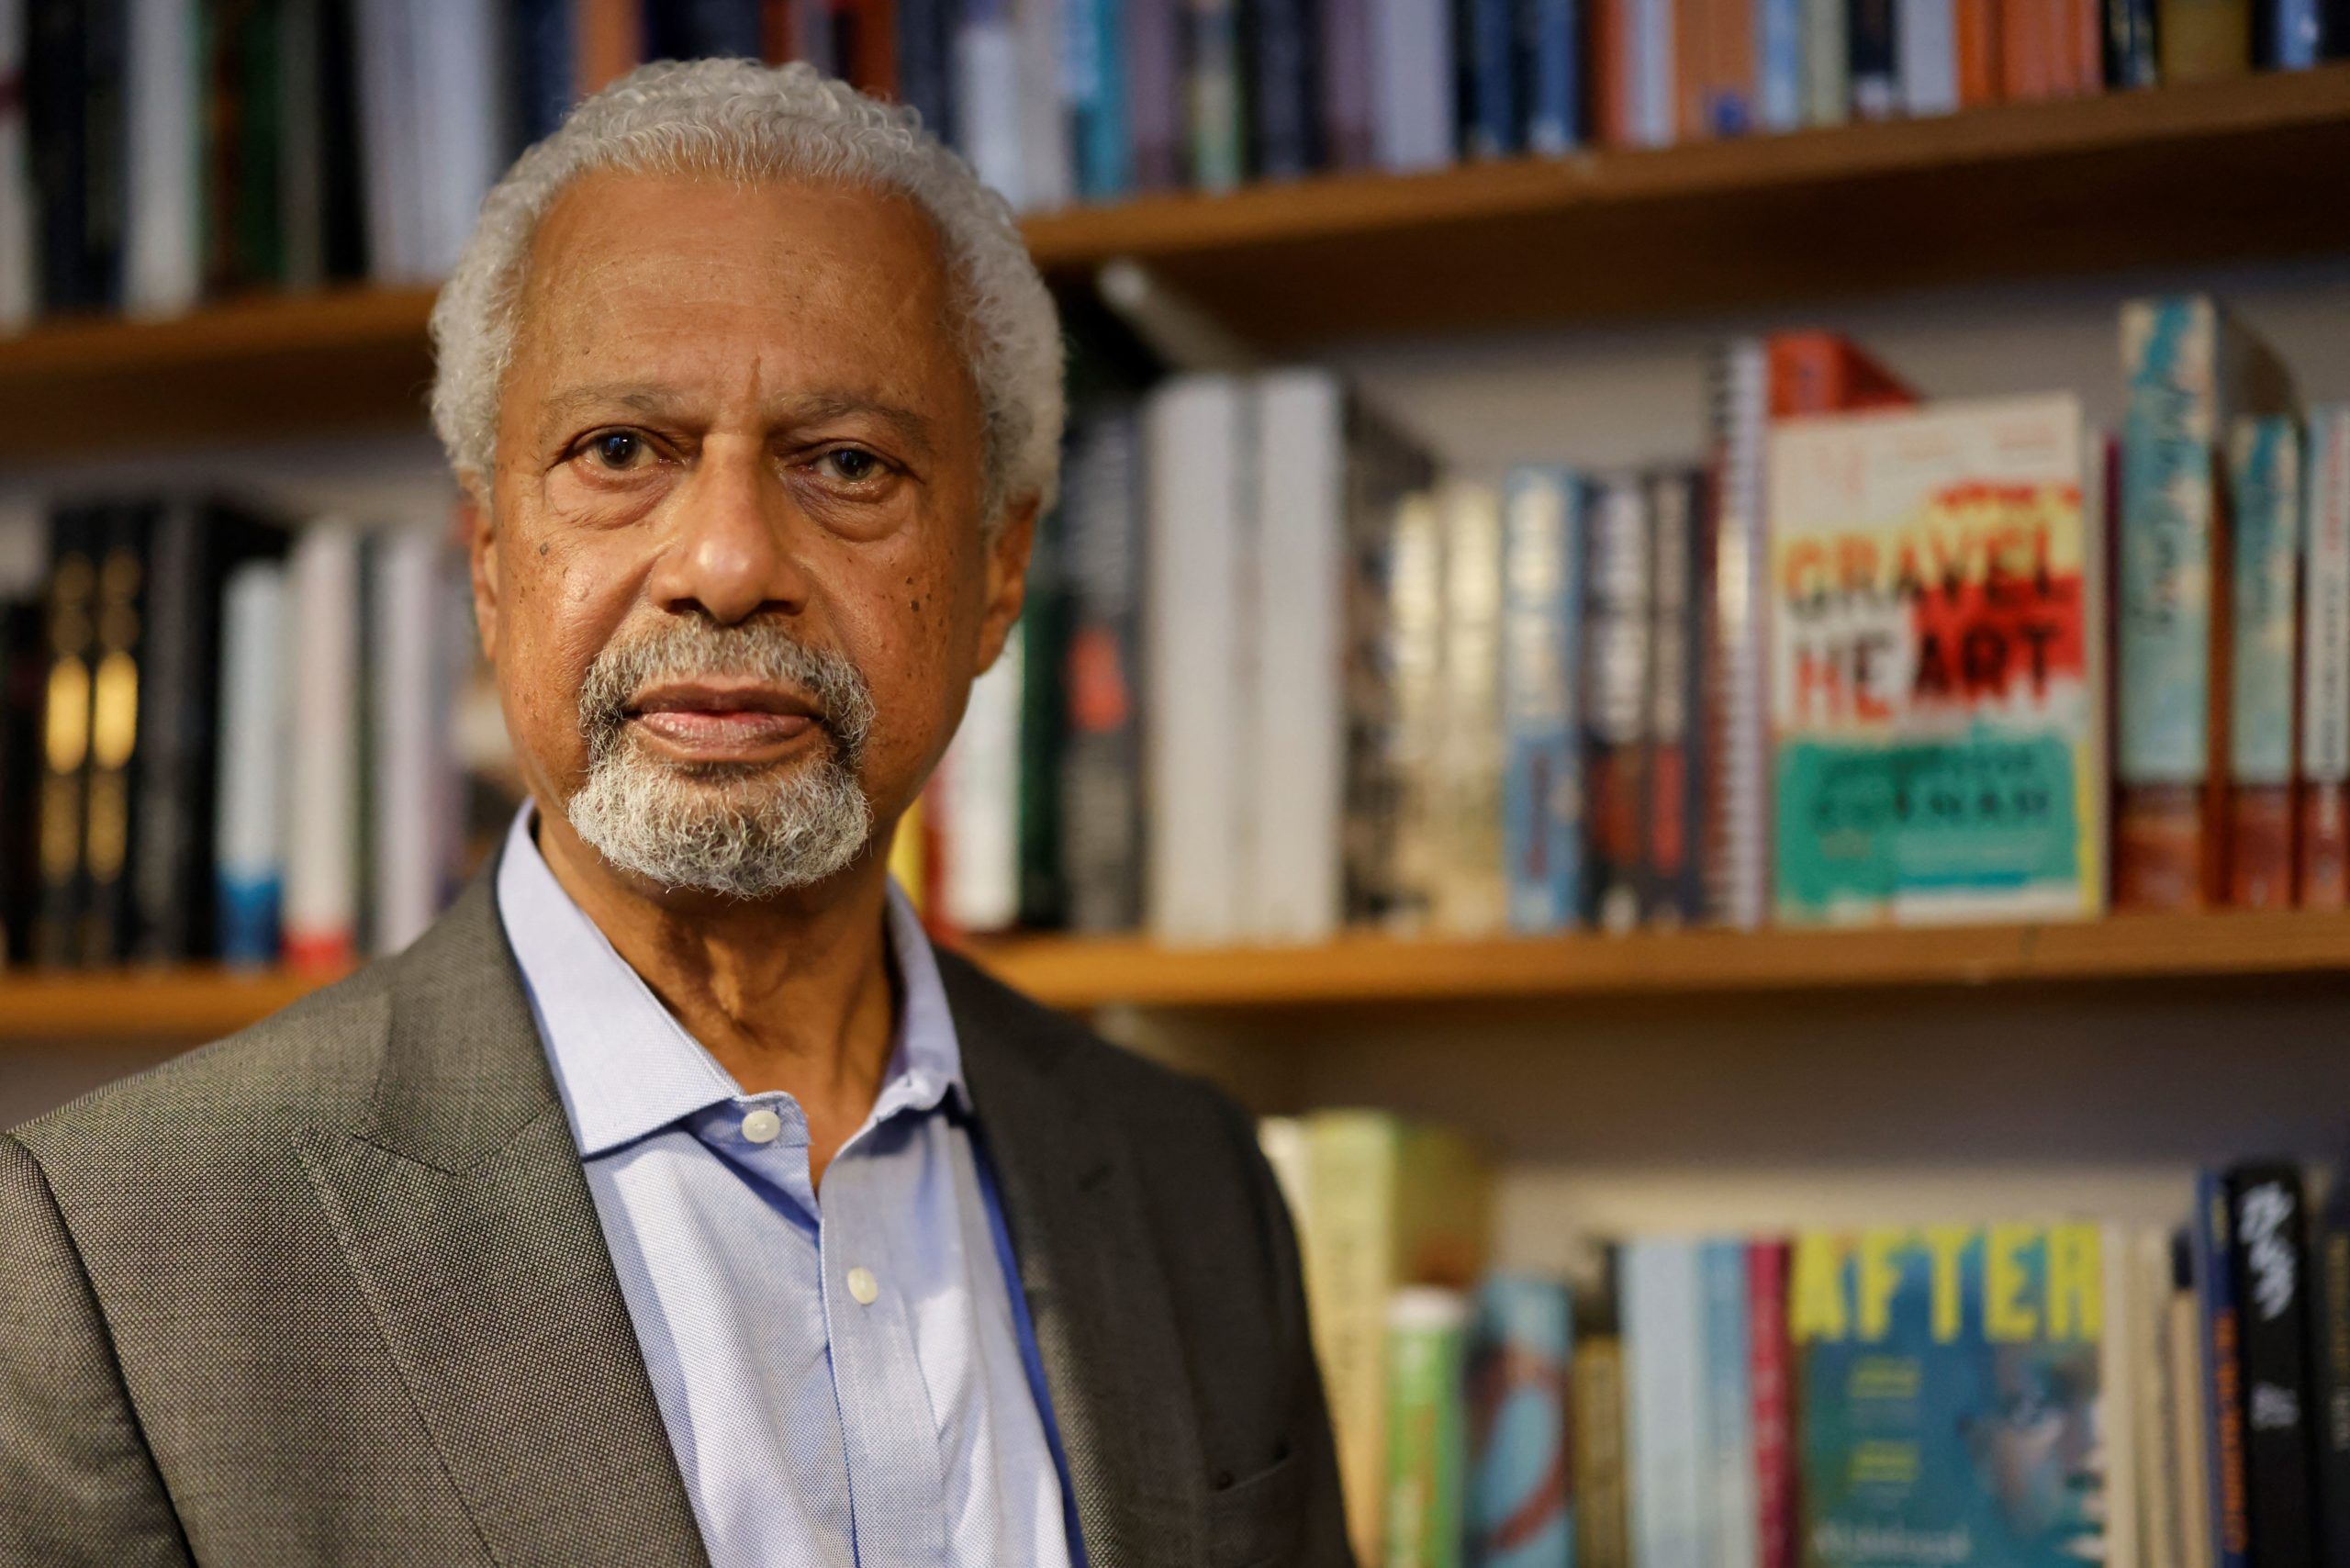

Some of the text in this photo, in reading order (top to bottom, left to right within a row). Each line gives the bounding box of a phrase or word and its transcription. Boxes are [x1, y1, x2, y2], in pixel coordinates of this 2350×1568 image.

[1783, 525, 2065, 621] GRAVEL
[1792, 626, 2067, 723] HEART
[1789, 1223, 2103, 1344] AFTER
